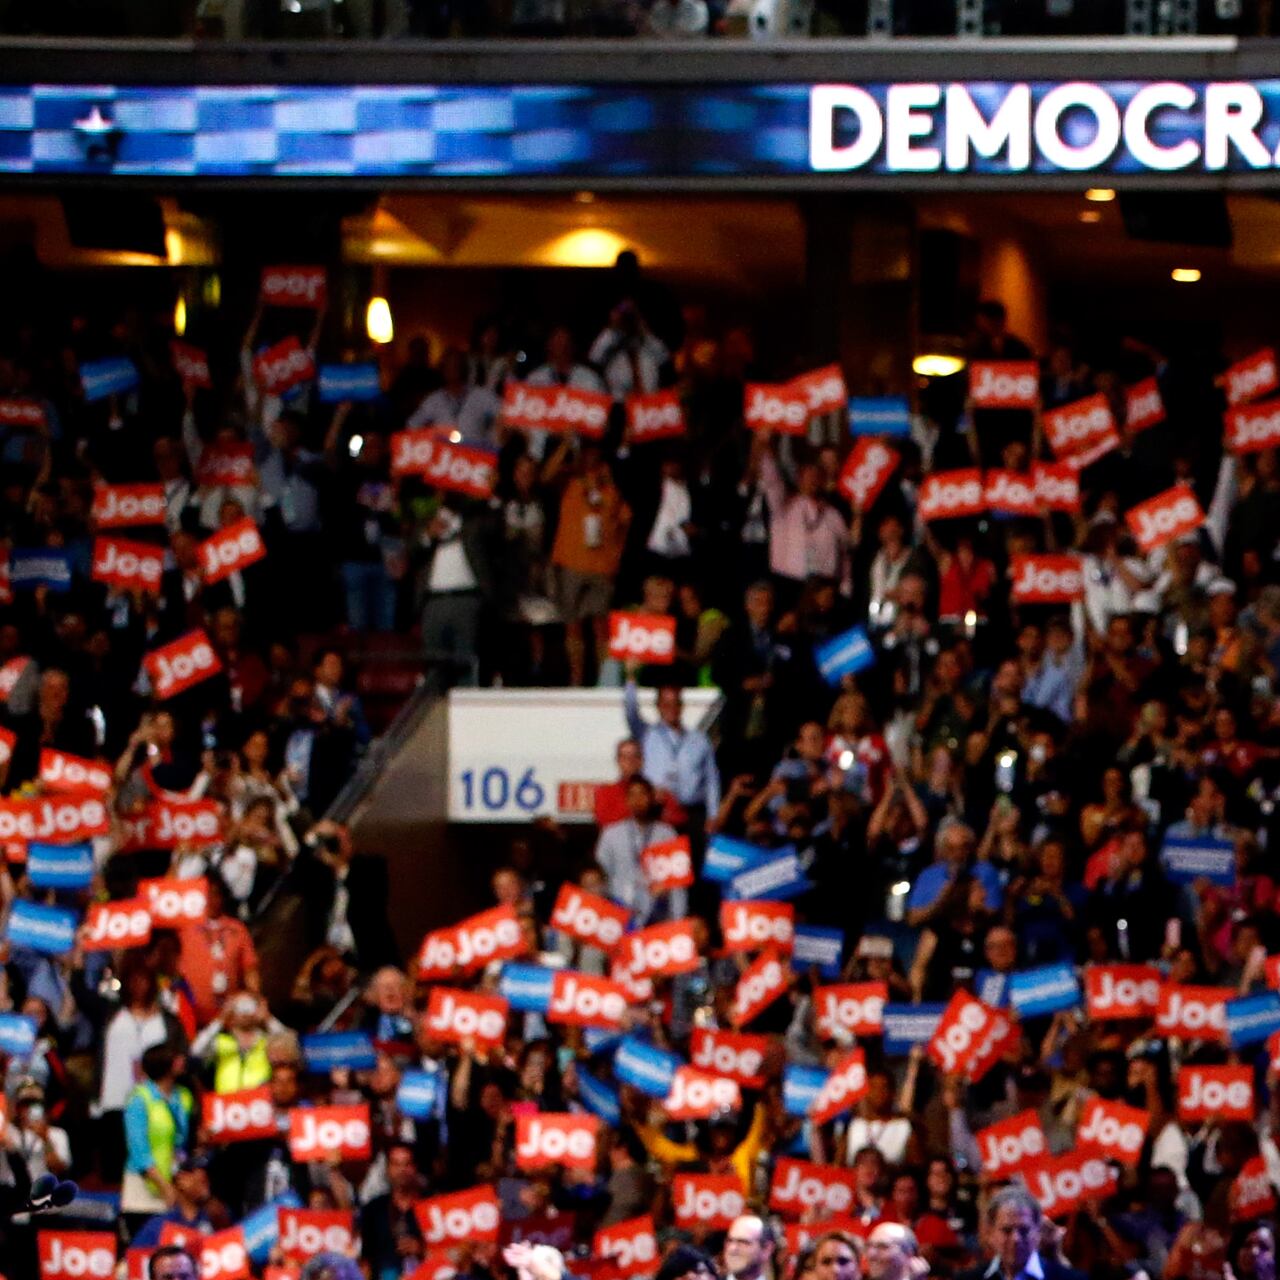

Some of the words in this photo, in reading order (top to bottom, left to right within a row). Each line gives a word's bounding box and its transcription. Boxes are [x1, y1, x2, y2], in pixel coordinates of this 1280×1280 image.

[974, 364, 1038, 401] Joe
[504, 386, 546, 419] Jo
[546, 391, 607, 431] Joe
[634, 400, 682, 433] Joe
[752, 391, 807, 426] Joe
[1051, 407, 1114, 448] Joe
[395, 435, 434, 465] Jo
[429, 447, 488, 488] Joe
[838, 442, 891, 500] Joe
[98, 488, 164, 518] Joe
[924, 481, 984, 511] Joe
[985, 477, 1036, 507] Jo
[1134, 498, 1200, 543] Joe
[95, 544, 162, 582] Joe
[205, 530, 260, 574] Joe
[1013, 563, 1083, 595] Joe
[609, 623, 676, 655] Joe
[154, 641, 214, 688] Joe
[40, 755, 112, 789] Joe
[460, 766, 546, 811] 106
[39, 799, 104, 836] Joe
[157, 807, 219, 841] Joe
[90, 909, 152, 940] Joe
[455, 919, 523, 960] Joe
[552, 896, 625, 946] Joe
[724, 909, 795, 944] Joe
[420, 940, 456, 970] Jo
[629, 931, 696, 974] Joe
[553, 987, 628, 1025] Joe
[735, 959, 784, 1016] Joe
[1090, 977, 1160, 1009] Joe
[430, 1001, 503, 1040] Joe
[823, 996, 885, 1033] Joe
[936, 1002, 987, 1070] Joe
[702, 1039, 762, 1079] Joe
[669, 1076, 740, 1113] Joe
[816, 1062, 867, 1112] Joe
[1180, 1074, 1254, 1108] Joe
[209, 1096, 273, 1131] Joe
[1079, 1106, 1144, 1153] Joe
[292, 1116, 371, 1151] Joe
[517, 1121, 596, 1158] Joe
[985, 1126, 1046, 1173] Joe
[773, 1168, 852, 1211] Joe
[1034, 1157, 1107, 1203] Joe
[675, 1182, 745, 1219] Joe
[280, 1216, 352, 1253] Joe
[425, 1199, 501, 1243] Joe
[43, 1238, 116, 1277] Joe
